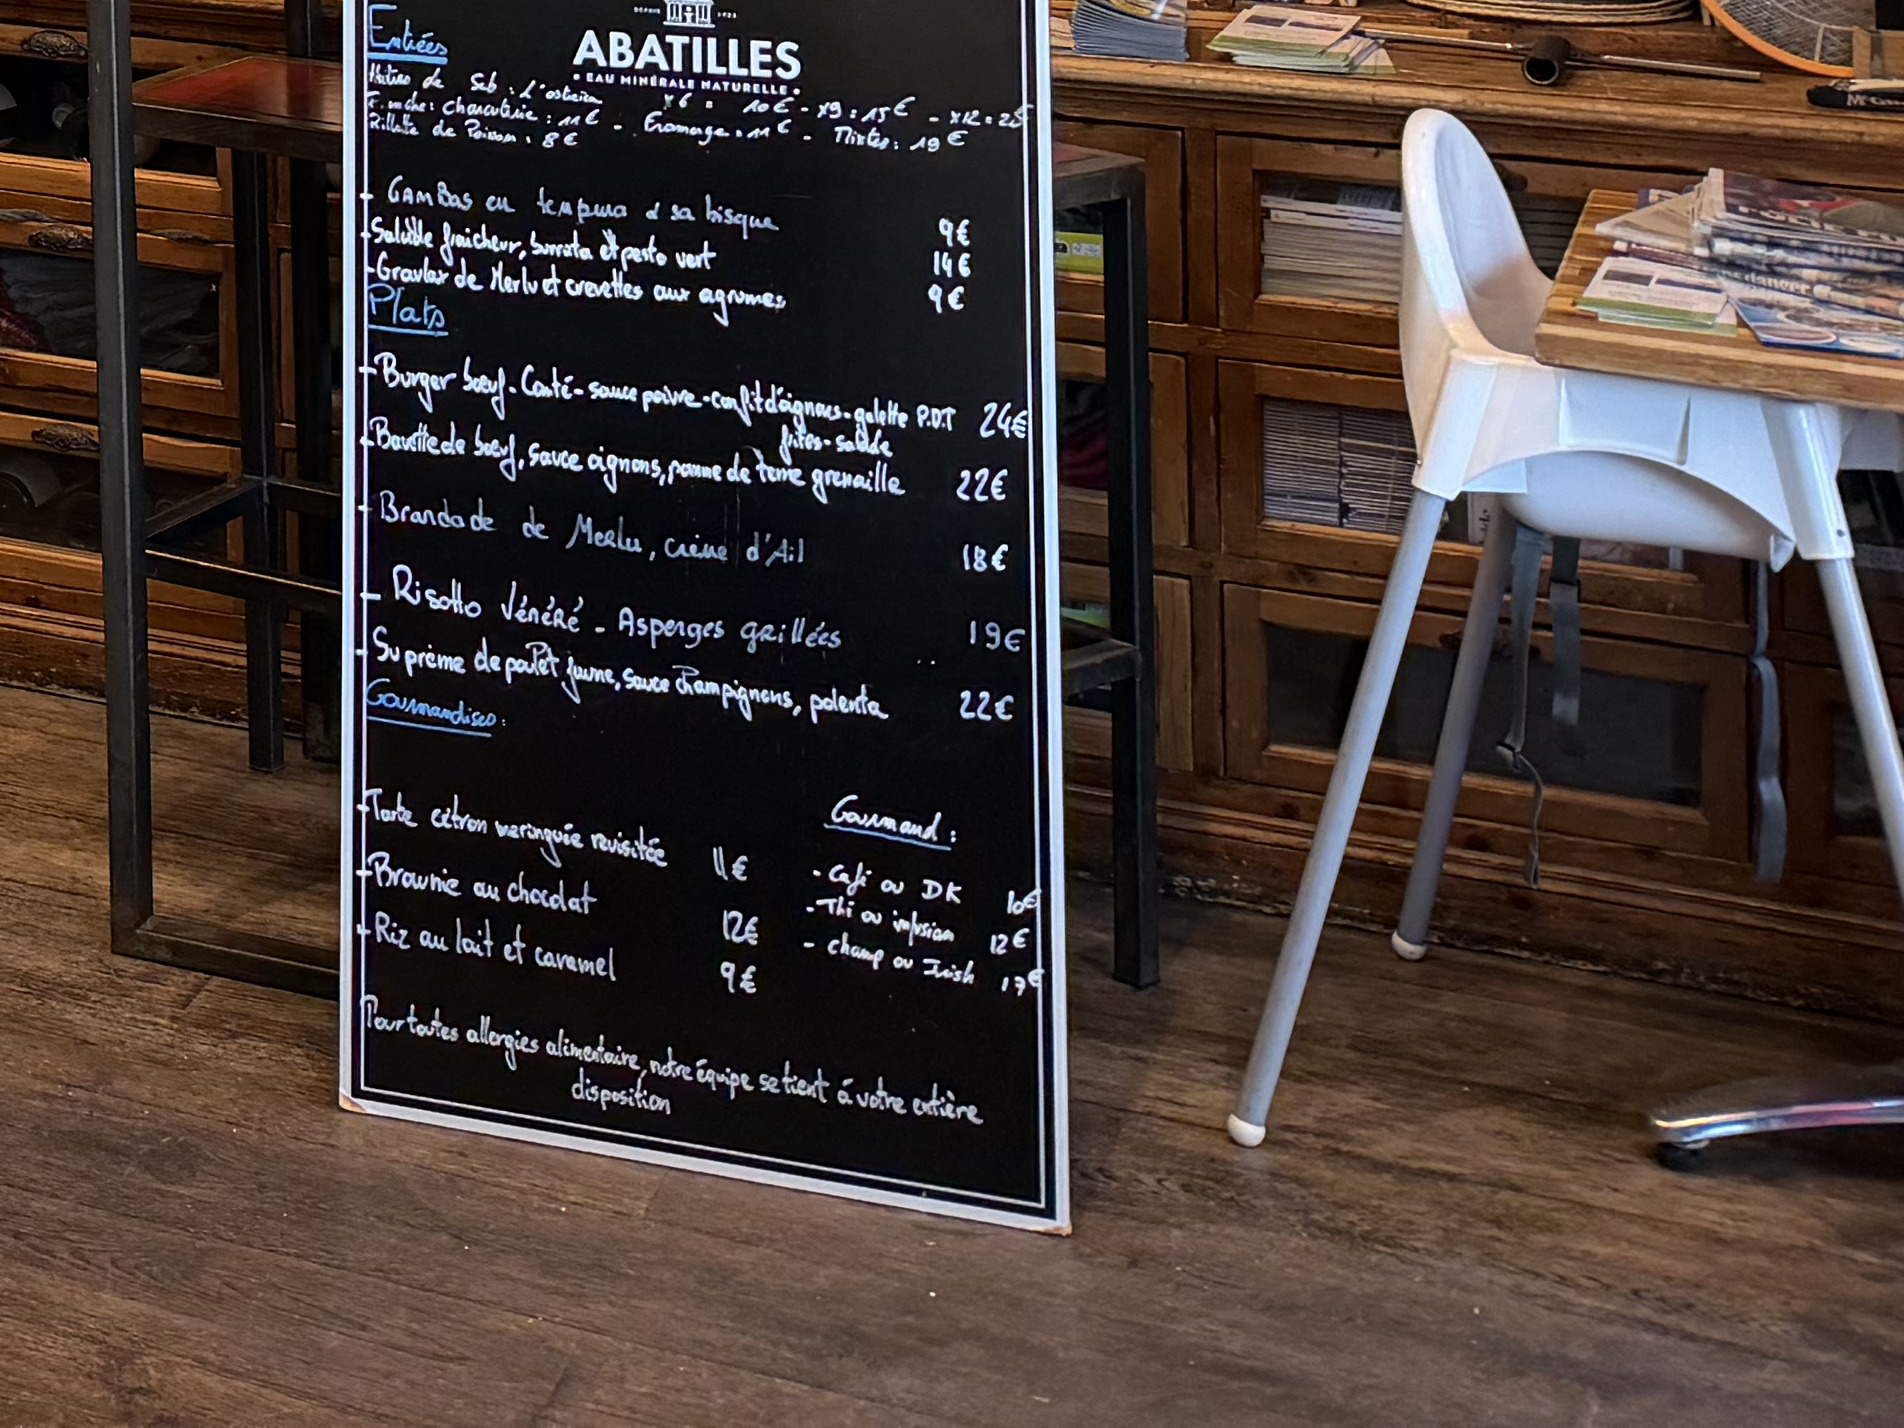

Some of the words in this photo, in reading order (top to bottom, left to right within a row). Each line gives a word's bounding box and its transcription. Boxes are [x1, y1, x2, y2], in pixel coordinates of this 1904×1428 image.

[369, 4, 448, 55] Entrées
[573, 30, 801, 80] ABATILLES
[586, 72, 615, 84] EAU
[621, 72, 695, 89] MINÉRALE
[701, 80, 788, 95] NATURELLE
[705, 194, 779, 240] bisque
[675, 240, 717, 270] vert
[368, 283, 446, 330] Plats
[454, 257, 484, 292] de
[490, 261, 538, 295] Merlu
[542, 264, 561, 296] et
[565, 268, 643, 301] crevettes
[699, 288, 787, 327] agrumes
[374, 352, 457, 414] Burger
[726, 452, 751, 484] de
[812, 460, 906, 504] grenaille
[956, 468, 1008, 502] 22€
[523, 505, 549, 540] de
[963, 544, 1008, 571] 18€
[392, 564, 482, 618] Risotto
[474, 636, 501, 673] de
[810, 683, 889, 724] polenta
[960, 690, 1014, 722] 22€
[365, 787, 418, 828] Tarte
[367, 851, 462, 896] Brownie
[473, 880, 501, 903] au
[374, 911, 411, 950] Riz
[419, 929, 450, 951] au
[456, 917, 494, 958] lait
[503, 924, 526, 965] et
[535, 947, 617, 981] caramel
[406, 1003, 459, 1042] toutes
[466, 1015, 539, 1071] allergies
[649, 1046, 694, 1081] notre
[696, 1059, 755, 1100] équipe
[759, 1071, 781, 1093] se
[782, 1060, 830, 1104] tient
[856, 1076, 907, 1114] votre
[912, 1082, 984, 1125] entière
[572, 1066, 671, 1115] disposition
